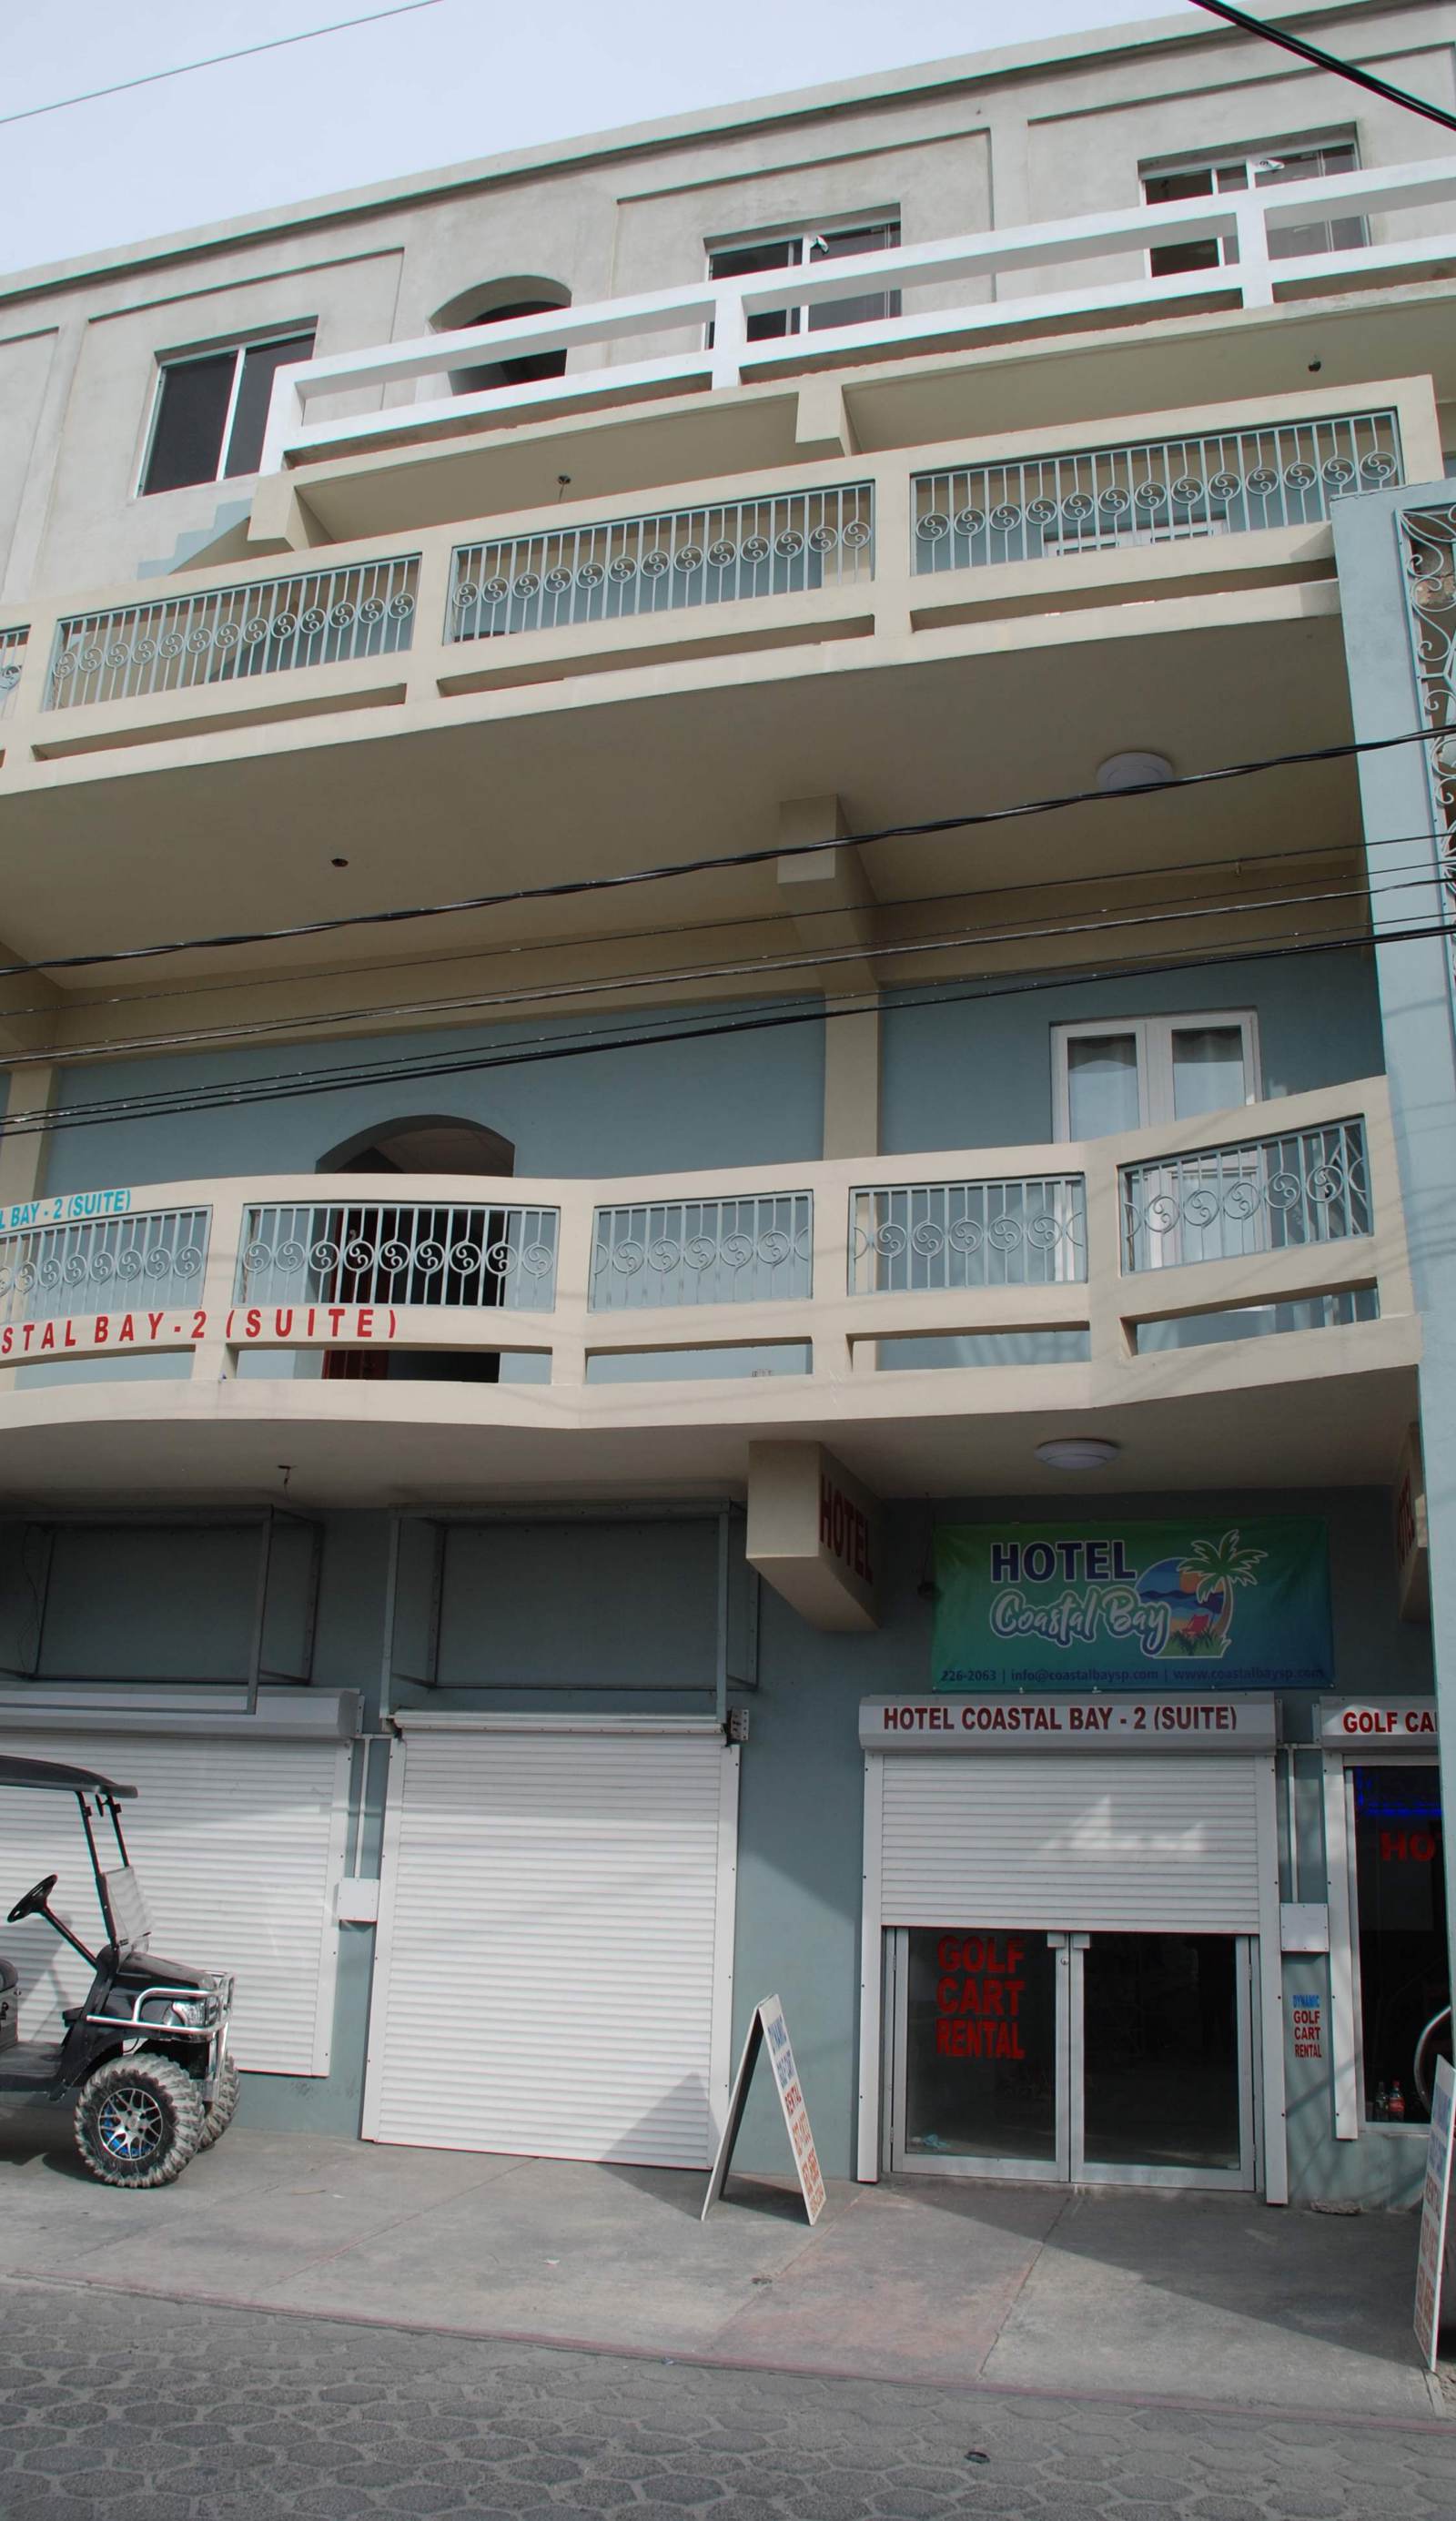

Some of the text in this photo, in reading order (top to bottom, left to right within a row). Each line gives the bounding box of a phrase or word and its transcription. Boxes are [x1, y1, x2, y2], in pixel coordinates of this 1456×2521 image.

[11, 1202, 40, 1227] BAY
[53, 1199, 63, 1220] 2
[67, 1190, 131, 1218] (SUITE)
[1, 1320, 76, 1354] STAL
[226, 1309, 396, 1338] (SUITE)
[820, 1473, 874, 1586] HOTEL
[991, 1541, 1137, 1582] HOTEL
[993, 1586, 1168, 1652] Coastal Bay
[941, 1670, 996, 1682] 226-2063
[1011, 1668, 1158, 1683] info@coastalbaysp.com
[884, 1707, 955, 1729] HOTEL
[961, 1707, 1062, 1729] COASTAL
[1070, 1707, 1113, 1729] BAY
[1134, 1707, 1147, 1729] 2
[1154, 1706, 1237, 1730] (SUITE)
[1343, 1712, 1437, 1733] GOLF CA
[1380, 1831, 1442, 1862] HO
[936, 1936, 1026, 1974] GOLF
[936, 1976, 1026, 2016] CART
[1293, 2010, 1320, 2024] GOLF
[1294, 2027, 1321, 2040] CART
[935, 2018, 1026, 2060] RENTAL
[1295, 2044, 1322, 2059] RENTAL
